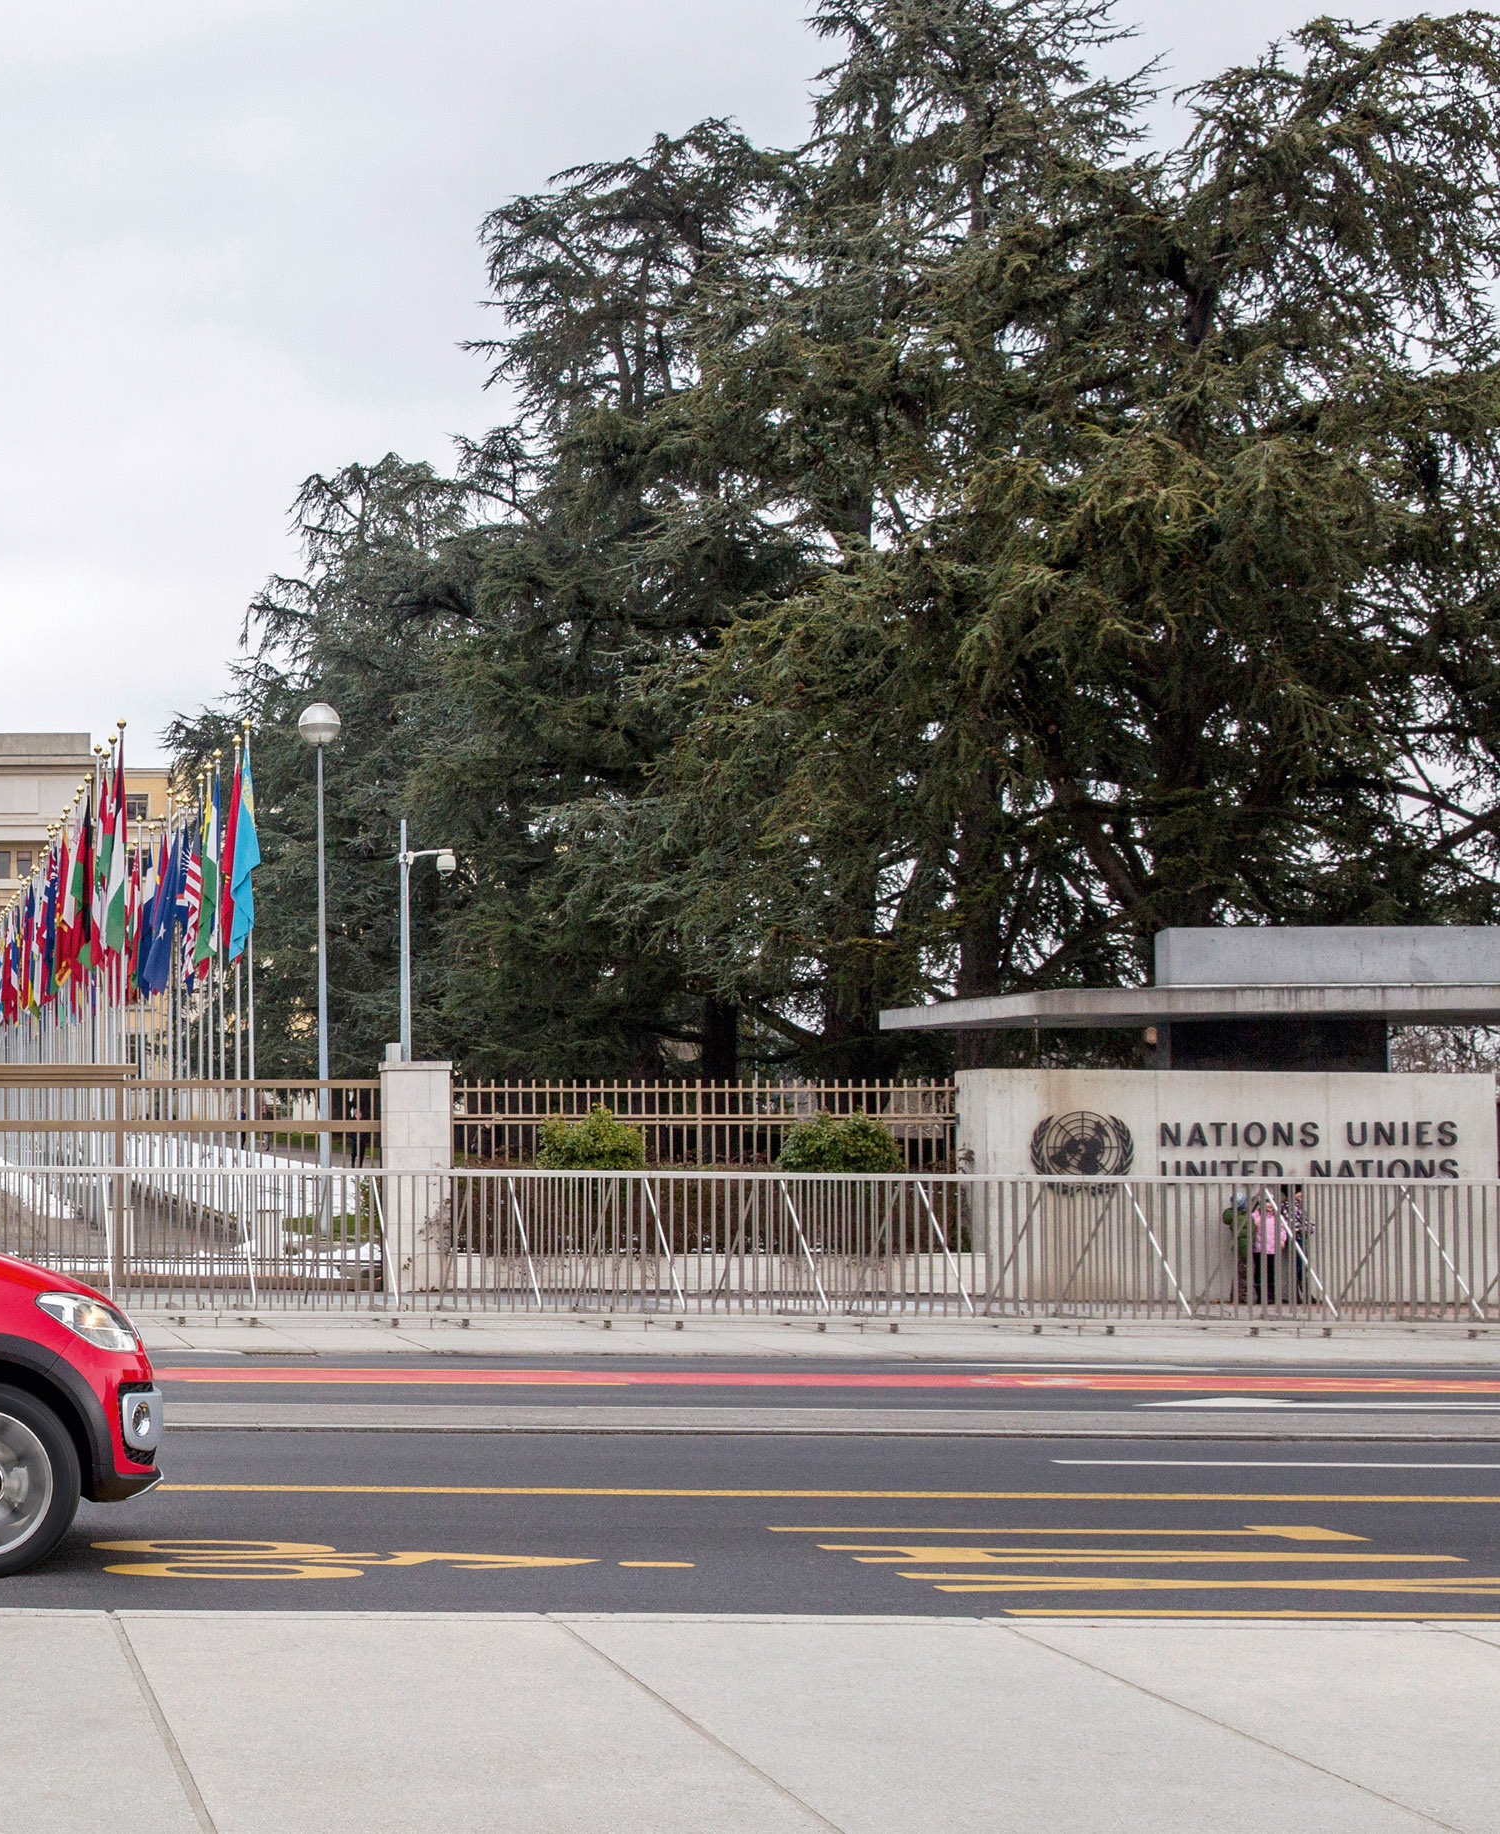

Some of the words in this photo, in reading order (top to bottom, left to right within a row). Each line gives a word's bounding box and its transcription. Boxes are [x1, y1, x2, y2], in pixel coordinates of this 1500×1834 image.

[1160, 1121, 1320, 1148] NATIONS
[1346, 1120, 1458, 1148] UNIES
[1310, 1158, 1460, 1179] NATIONS
